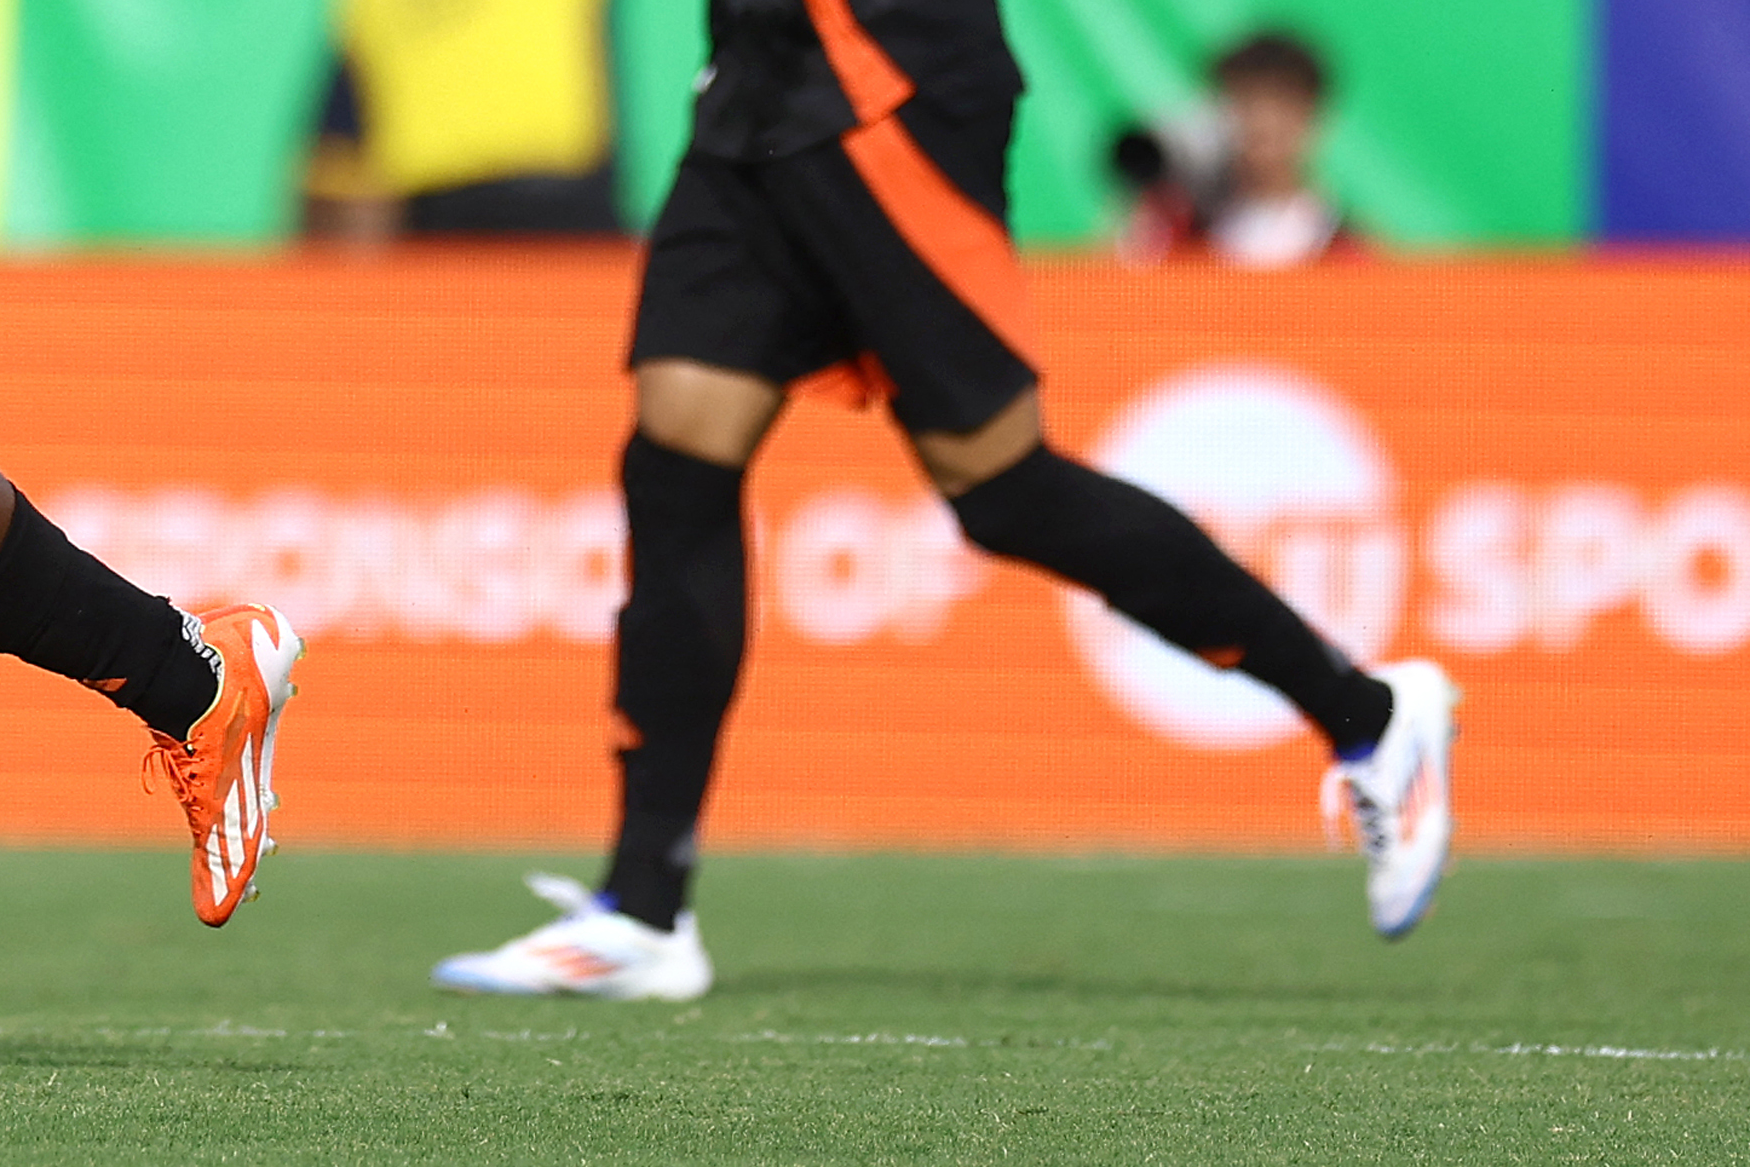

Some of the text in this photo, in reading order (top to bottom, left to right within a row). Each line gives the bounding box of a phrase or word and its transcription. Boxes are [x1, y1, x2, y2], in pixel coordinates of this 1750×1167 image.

[38, 486, 765, 645] PONSO
[772, 488, 990, 645] OF
[1422, 481, 1750, 656] SPO
